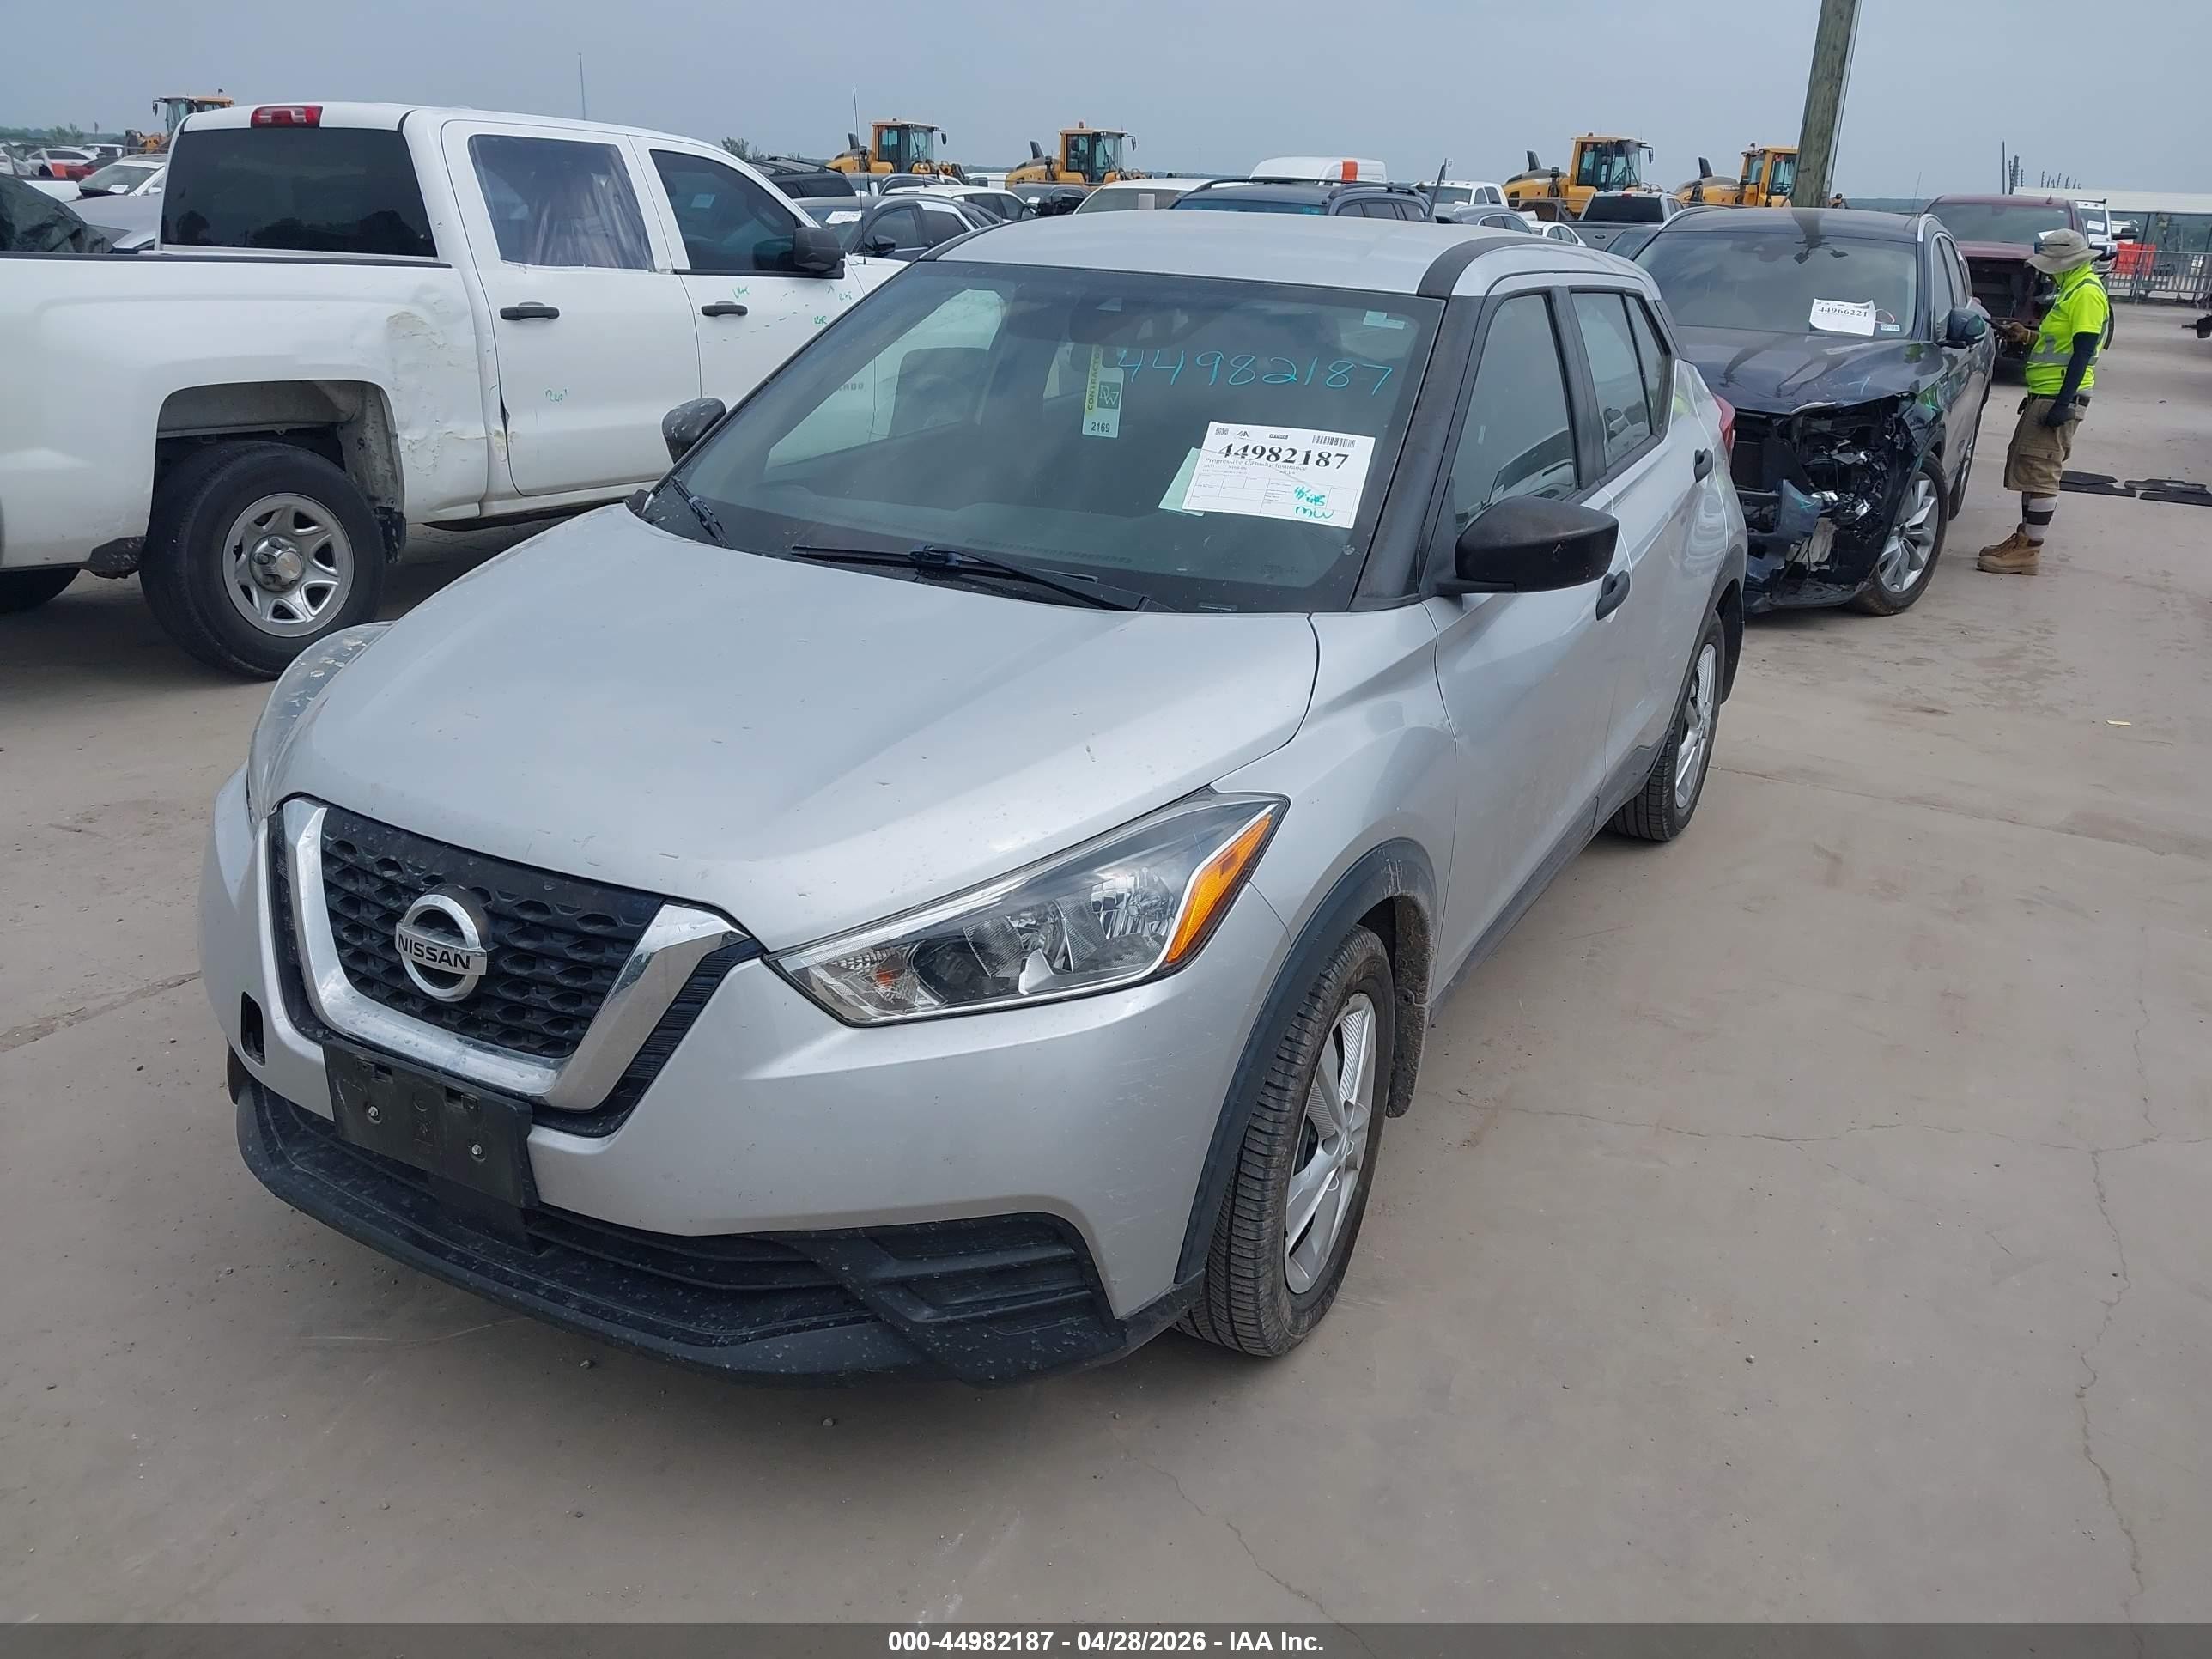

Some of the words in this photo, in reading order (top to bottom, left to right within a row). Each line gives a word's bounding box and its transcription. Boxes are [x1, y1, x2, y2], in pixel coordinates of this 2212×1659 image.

[1818, 306, 1869, 317] 44966221
[1087, 351, 1100, 410] CONTRACTO
[1118, 349, 1393, 396] 44982187
[1091, 422, 1111, 433] 2169
[1218, 442, 1350, 470] 44982187
[398, 934, 471, 969] NISSAN
